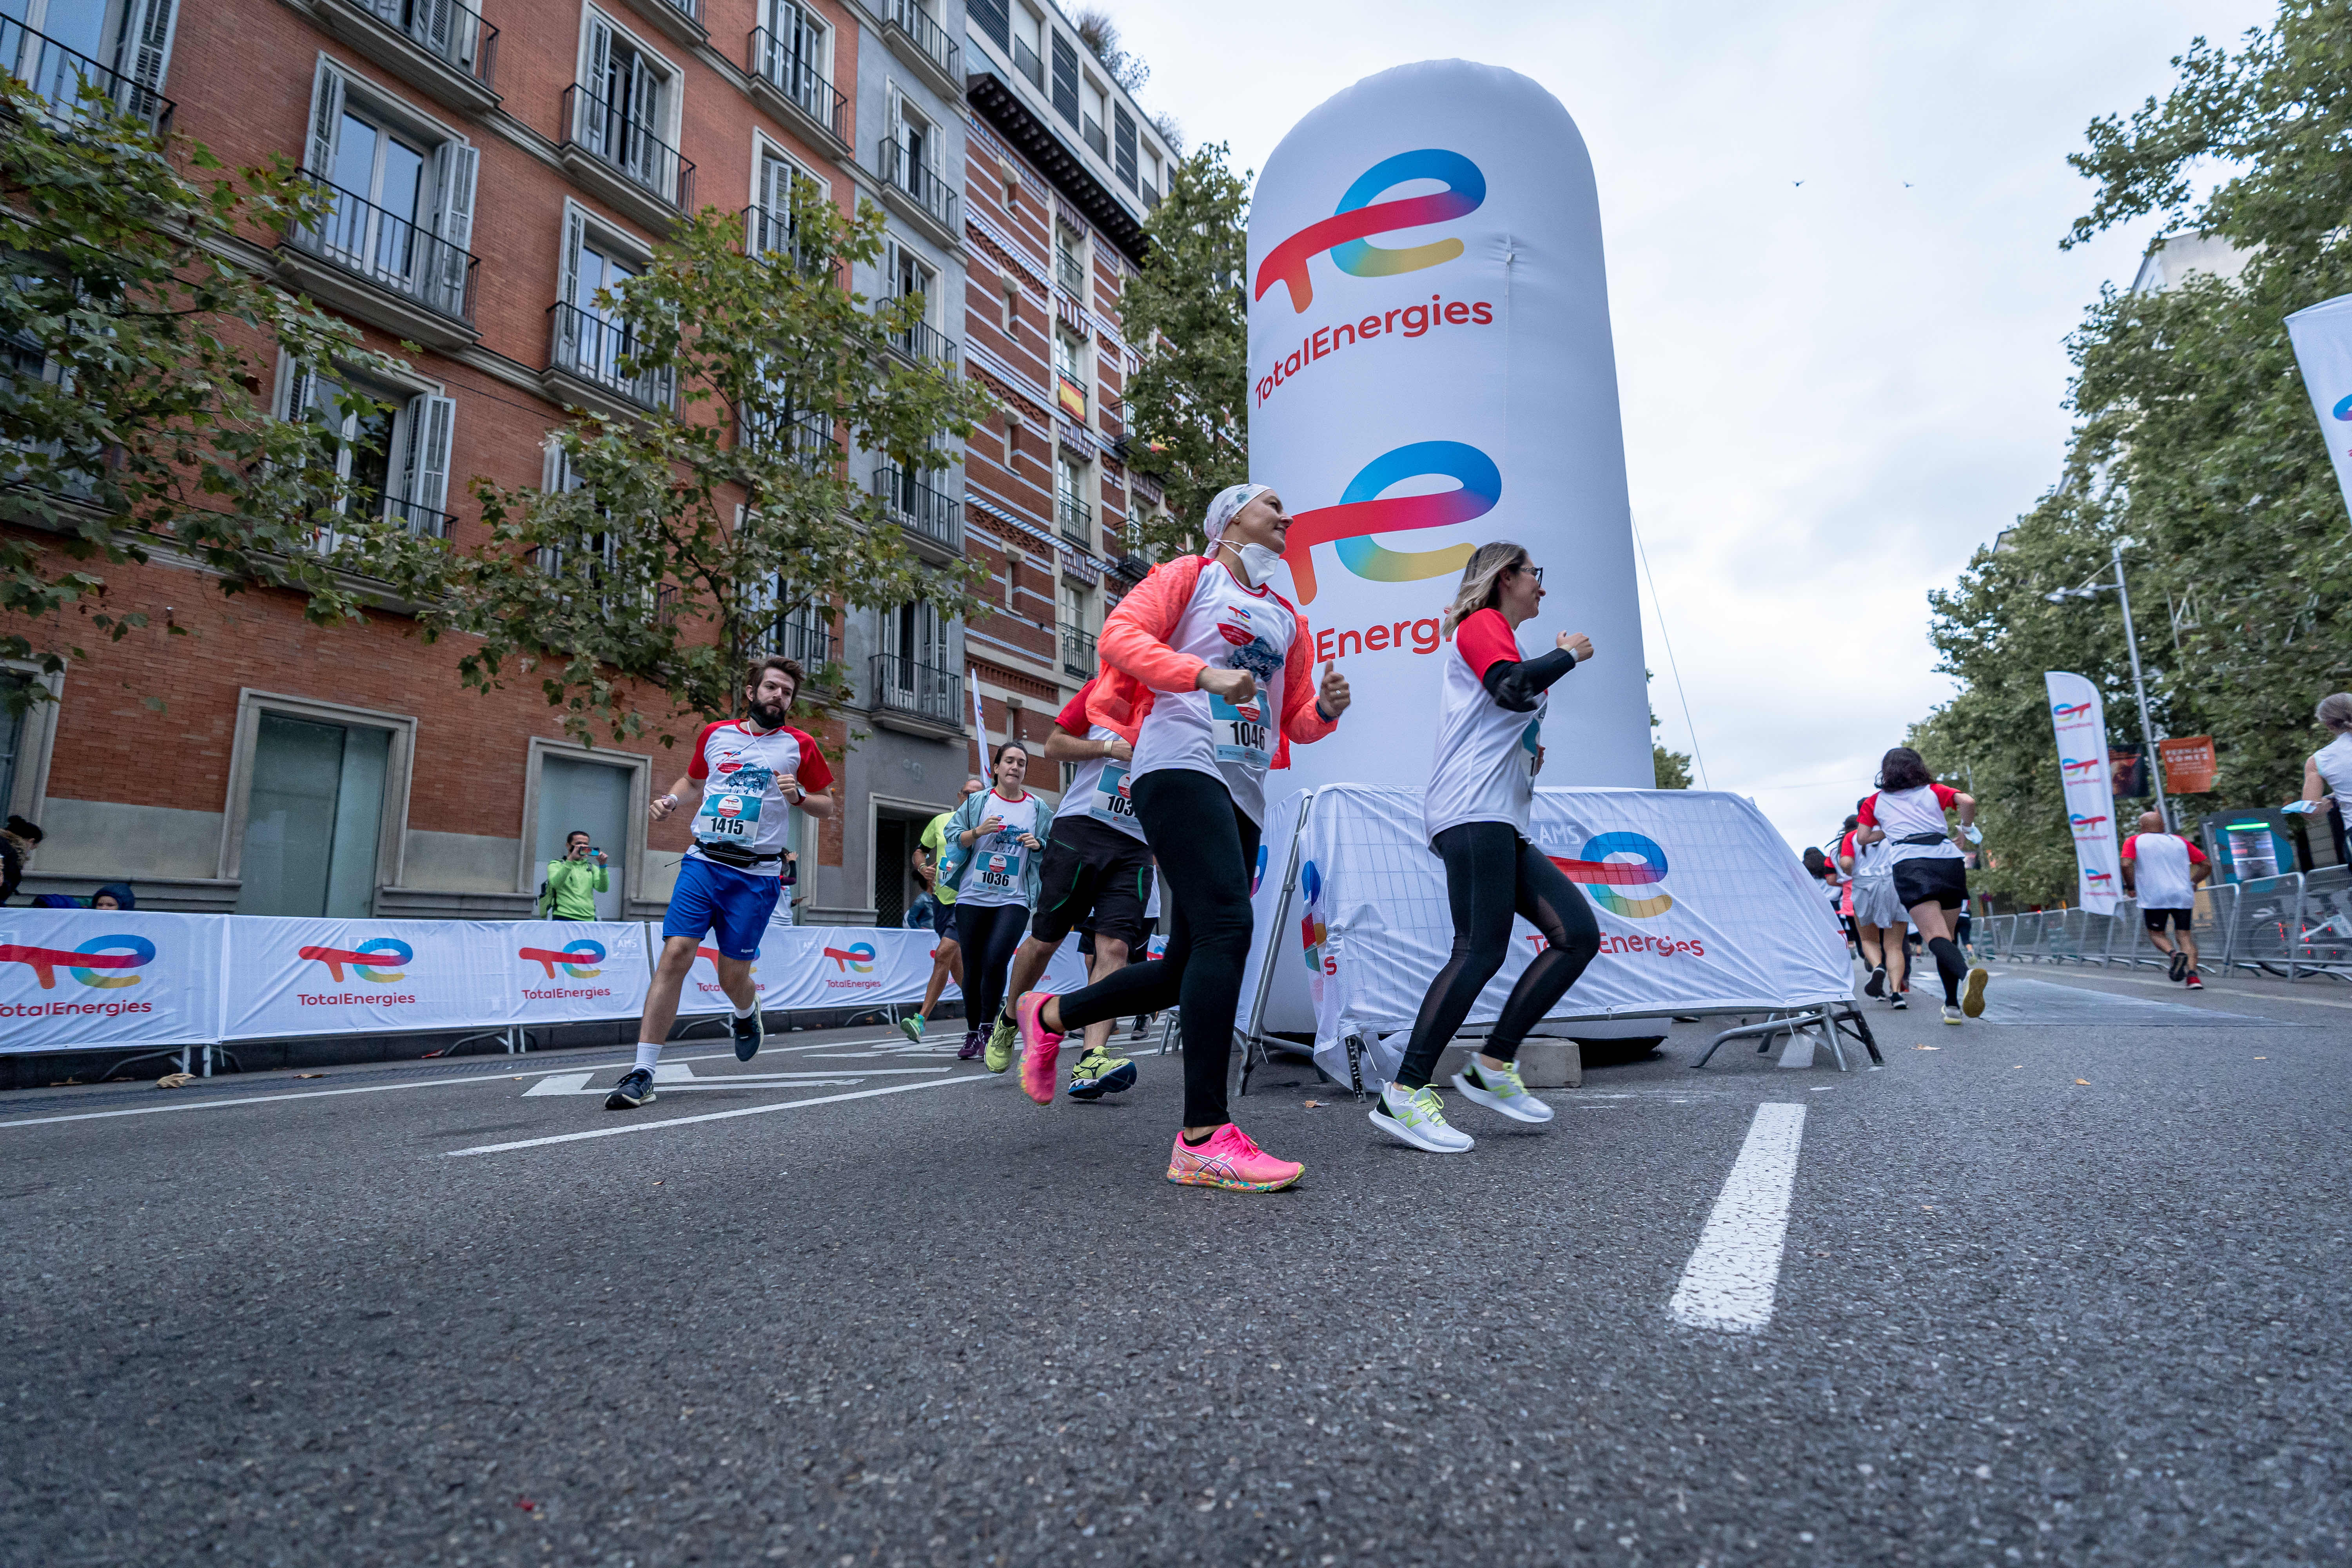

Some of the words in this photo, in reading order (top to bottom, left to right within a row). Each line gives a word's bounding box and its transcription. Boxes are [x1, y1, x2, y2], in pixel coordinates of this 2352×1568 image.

[1255, 294, 1492, 410] TotalEnergies
[1229, 721, 1265, 751] 1046
[1107, 795, 1134, 817] 103
[711, 817, 744, 835] 1415
[1539, 824, 1581, 844] AMS
[982, 871, 1010, 887] 1036
[522, 987, 611, 1000] TotalEnergies
[826, 980, 881, 989] TotalEnergies
[298, 992, 416, 1007] TotalEnergies
